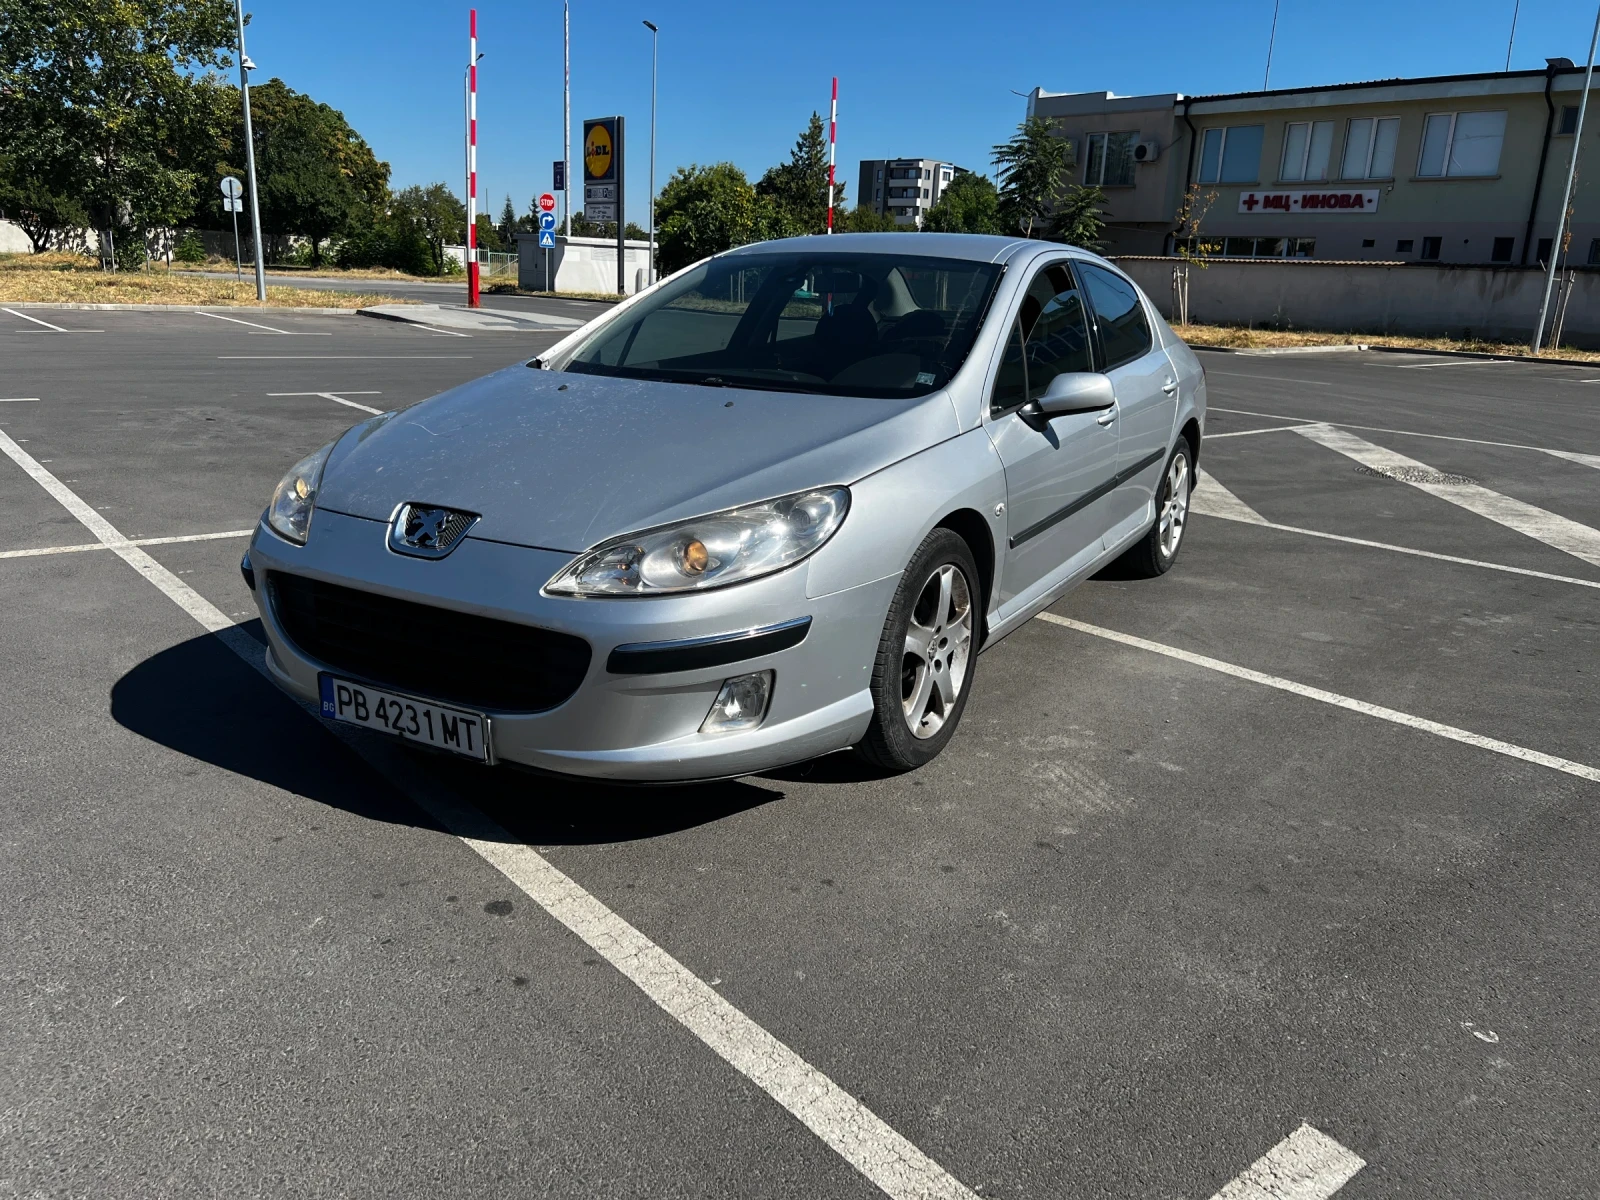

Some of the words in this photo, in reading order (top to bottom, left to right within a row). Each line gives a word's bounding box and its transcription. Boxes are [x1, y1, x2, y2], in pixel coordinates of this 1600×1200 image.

[1263, 195, 1290, 211] МЦ
[1301, 194, 1364, 209] ИНОВА
[323, 701, 335, 712] BG
[337, 685, 369, 721] PB
[375, 697, 435, 741] 4231
[440, 712, 476, 751] MT
